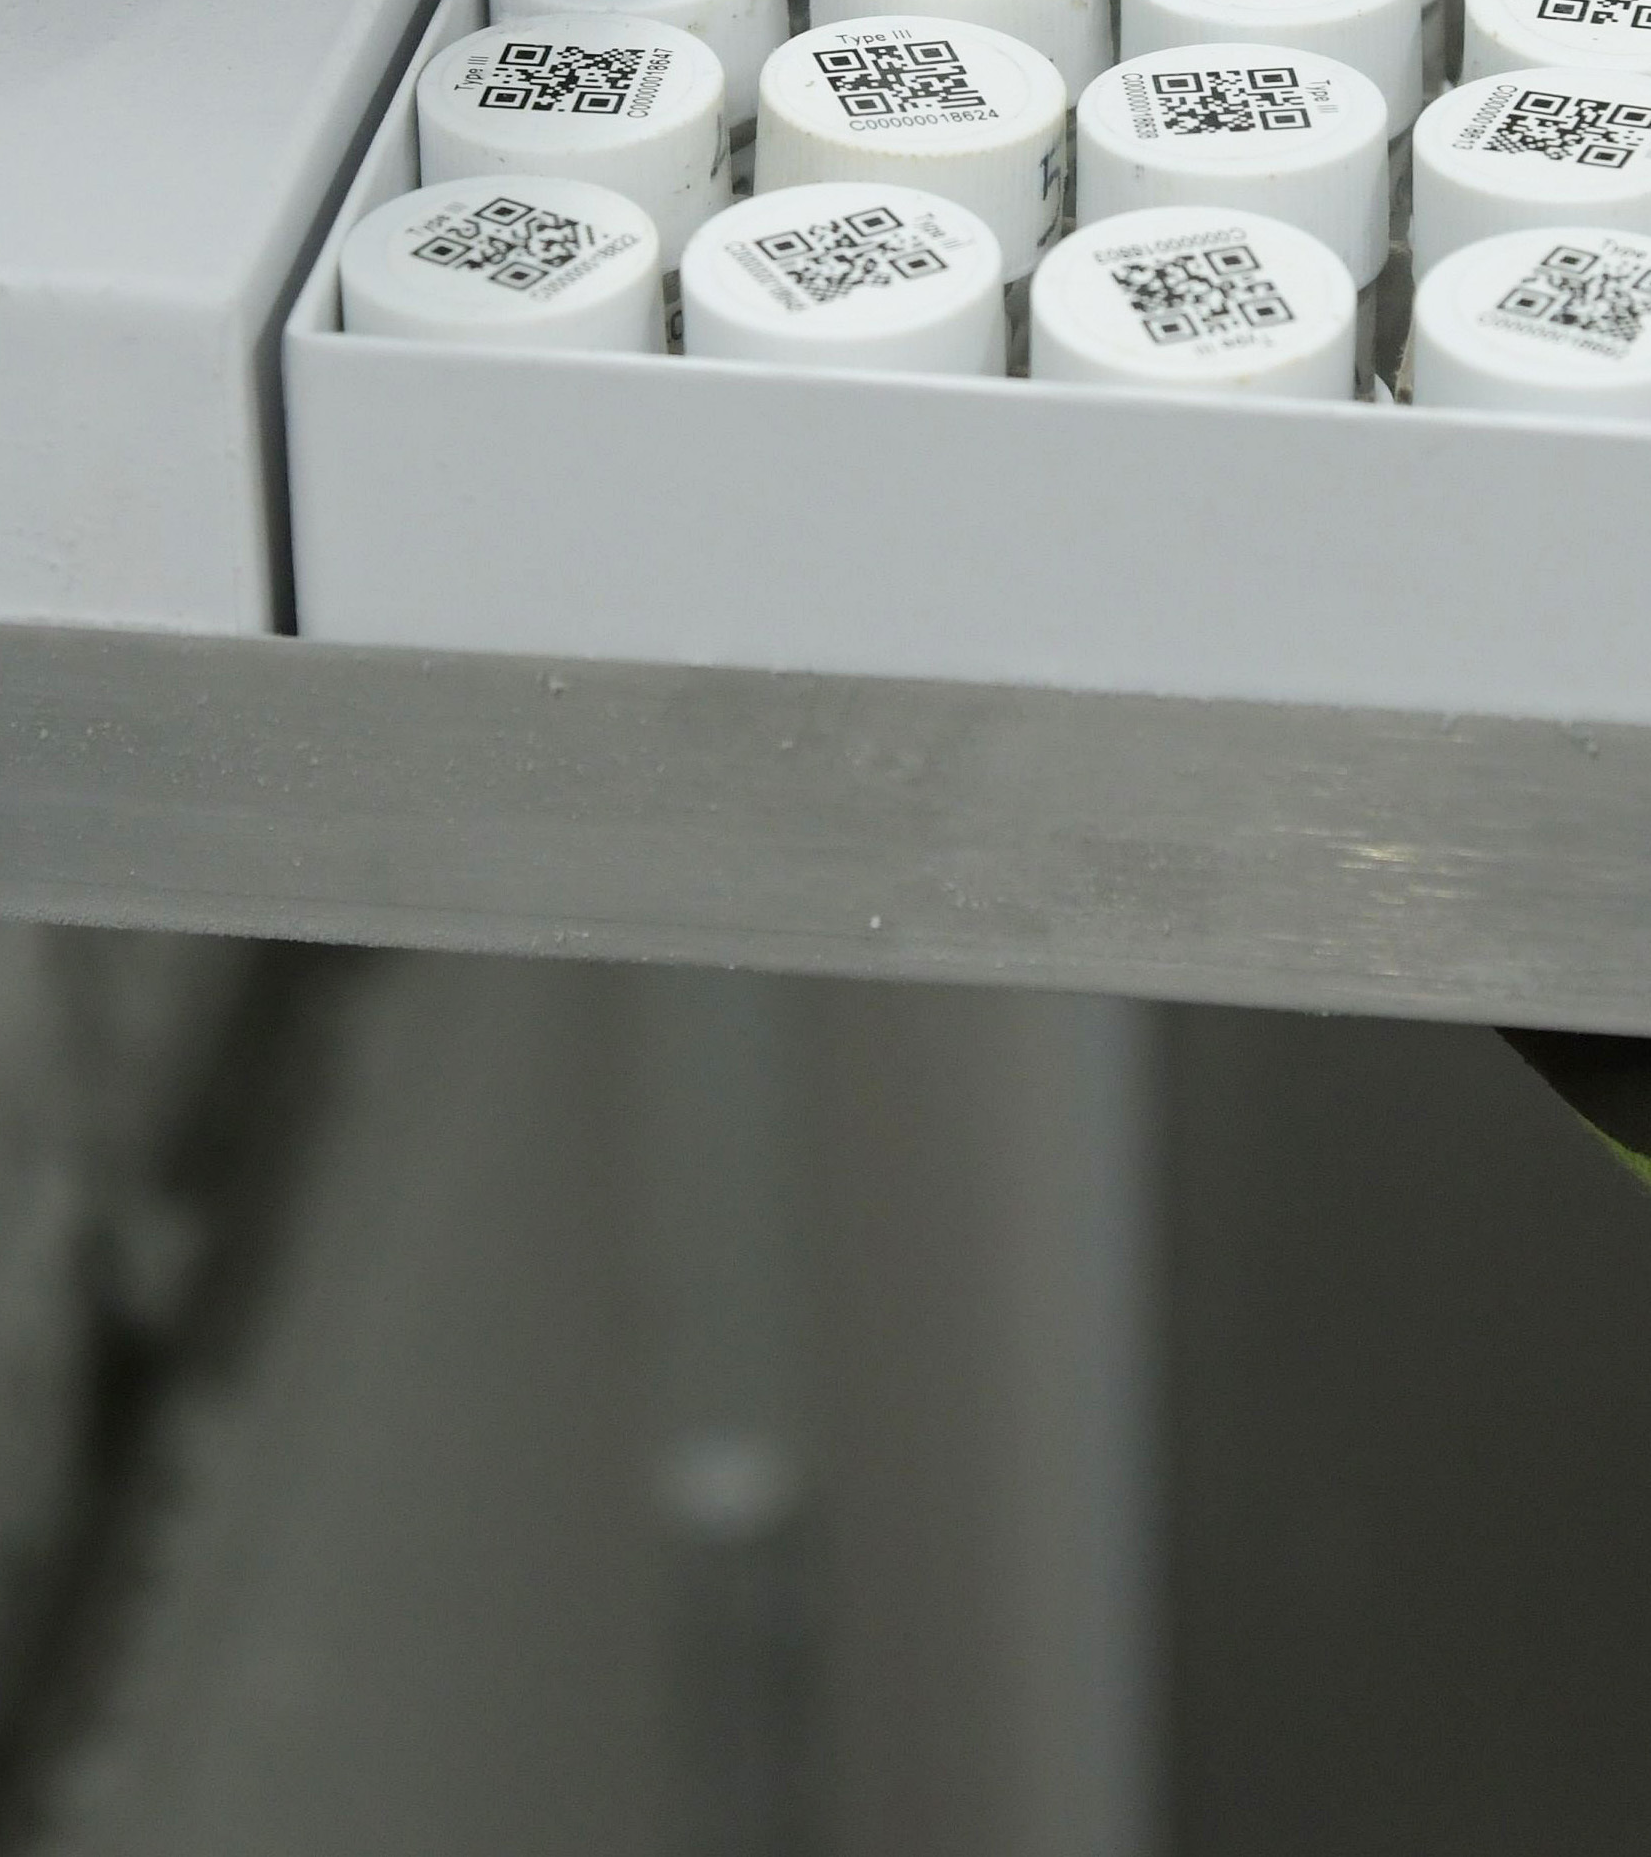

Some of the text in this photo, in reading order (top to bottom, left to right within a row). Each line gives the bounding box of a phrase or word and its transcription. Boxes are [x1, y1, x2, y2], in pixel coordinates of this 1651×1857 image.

[835, 30, 912, 46] Type III
[454, 56, 489, 90] Type III
[627, 48, 673, 118] C00000018647
[1306, 79, 1339, 113] Type III
[849, 109, 999, 131] C00000018624
